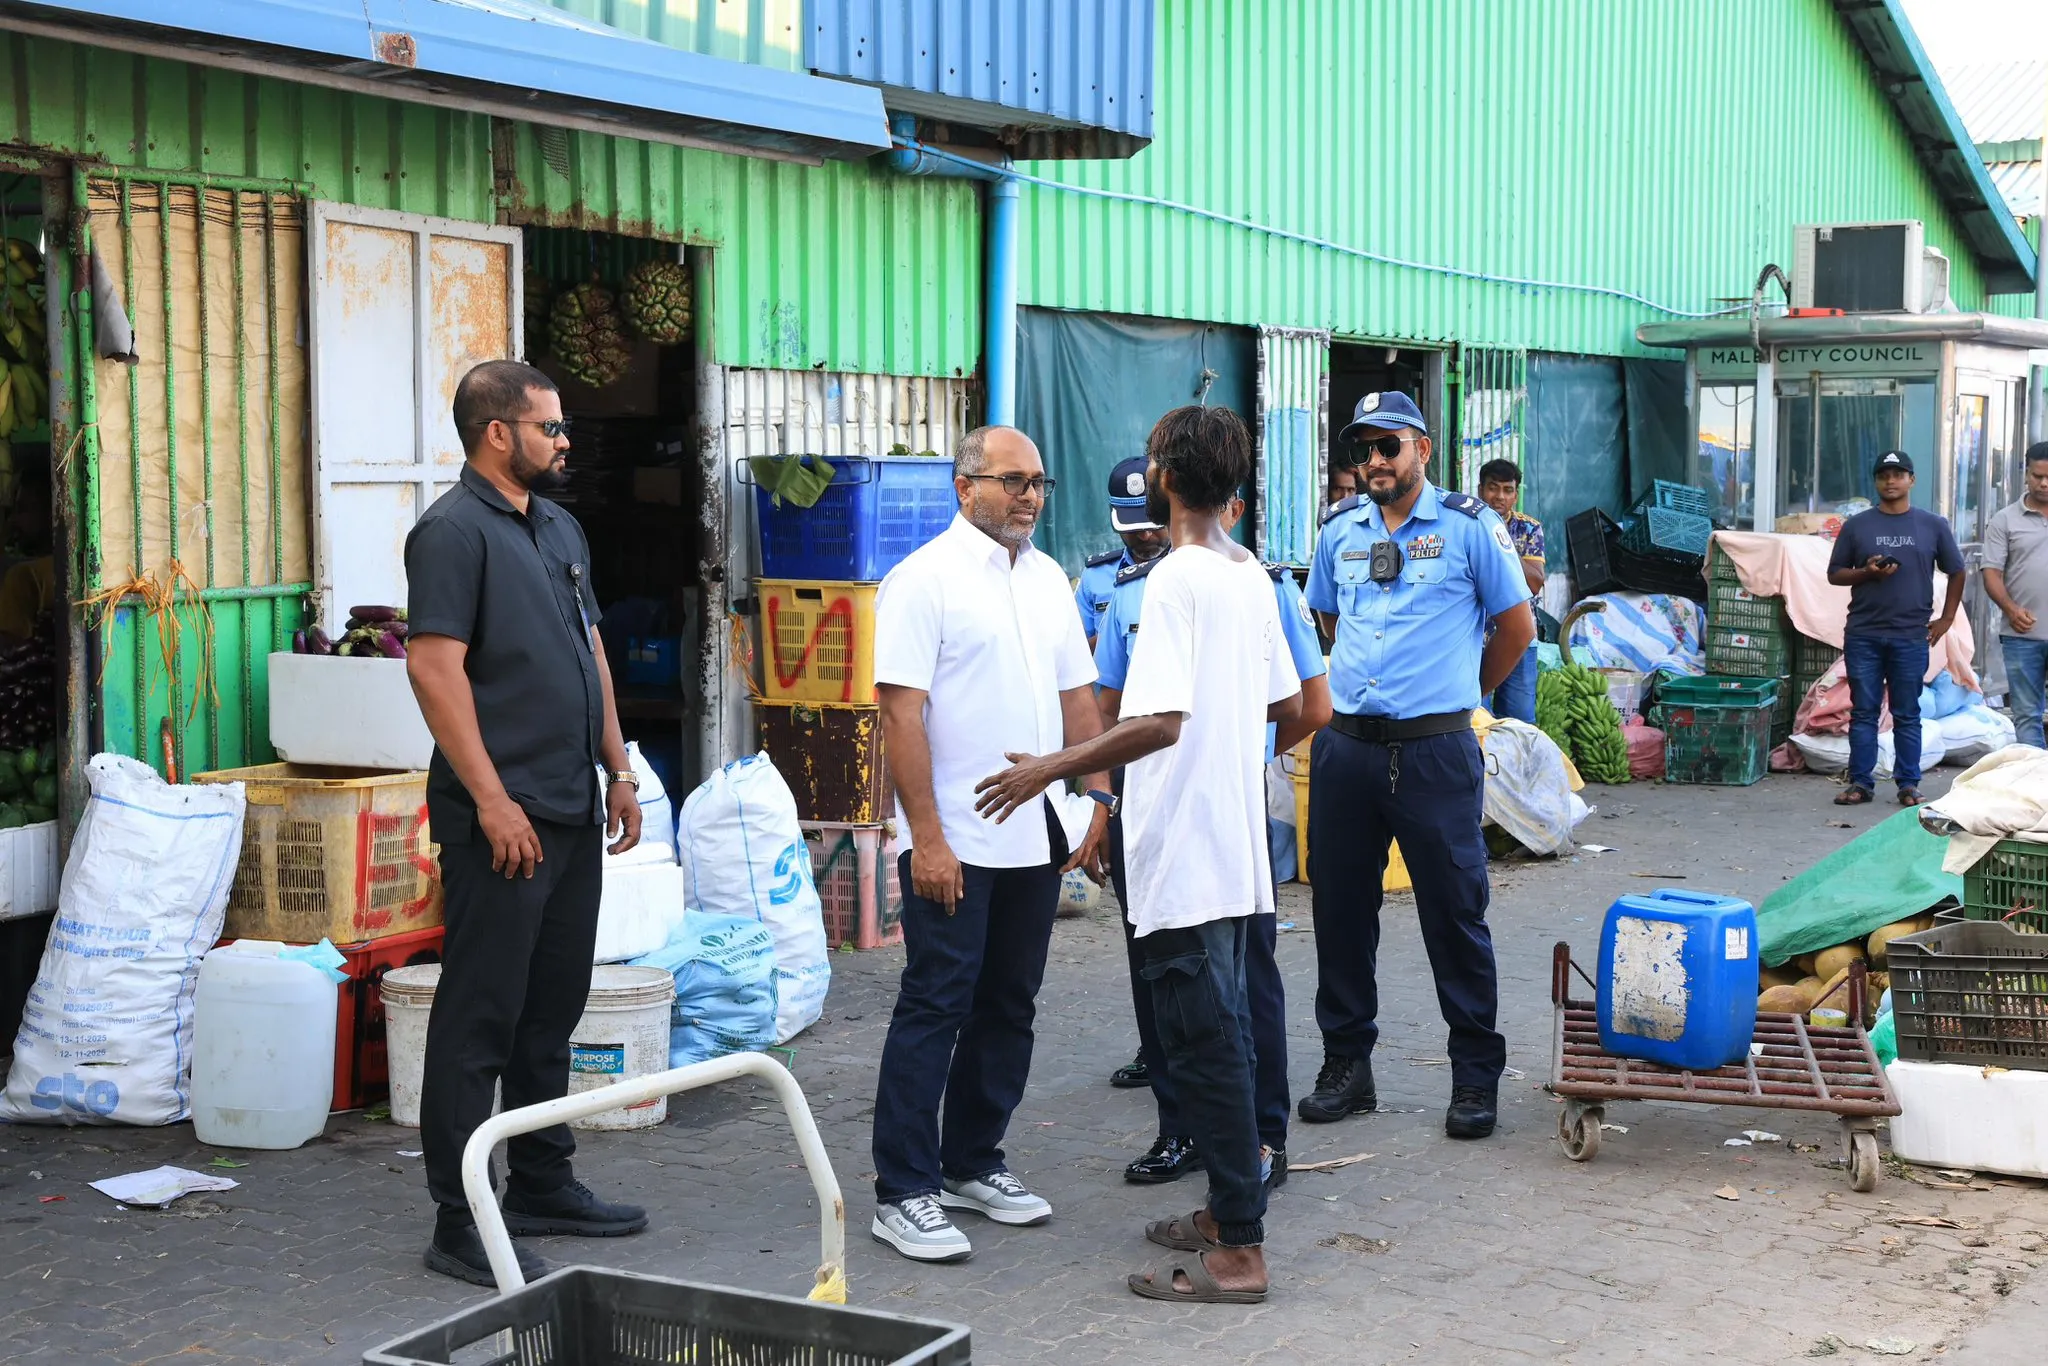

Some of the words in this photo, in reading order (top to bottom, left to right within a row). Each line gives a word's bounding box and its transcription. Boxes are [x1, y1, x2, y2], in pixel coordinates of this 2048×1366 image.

[1777, 348, 1824, 362] CITY
[1829, 347, 1923, 362] COUNCIL
[1876, 536, 1916, 546] PRADA
[99, 926, 151, 941] FLOUR
[572, 1052, 615, 1063] PURPOSE
[30, 1073, 120, 1117] sto
